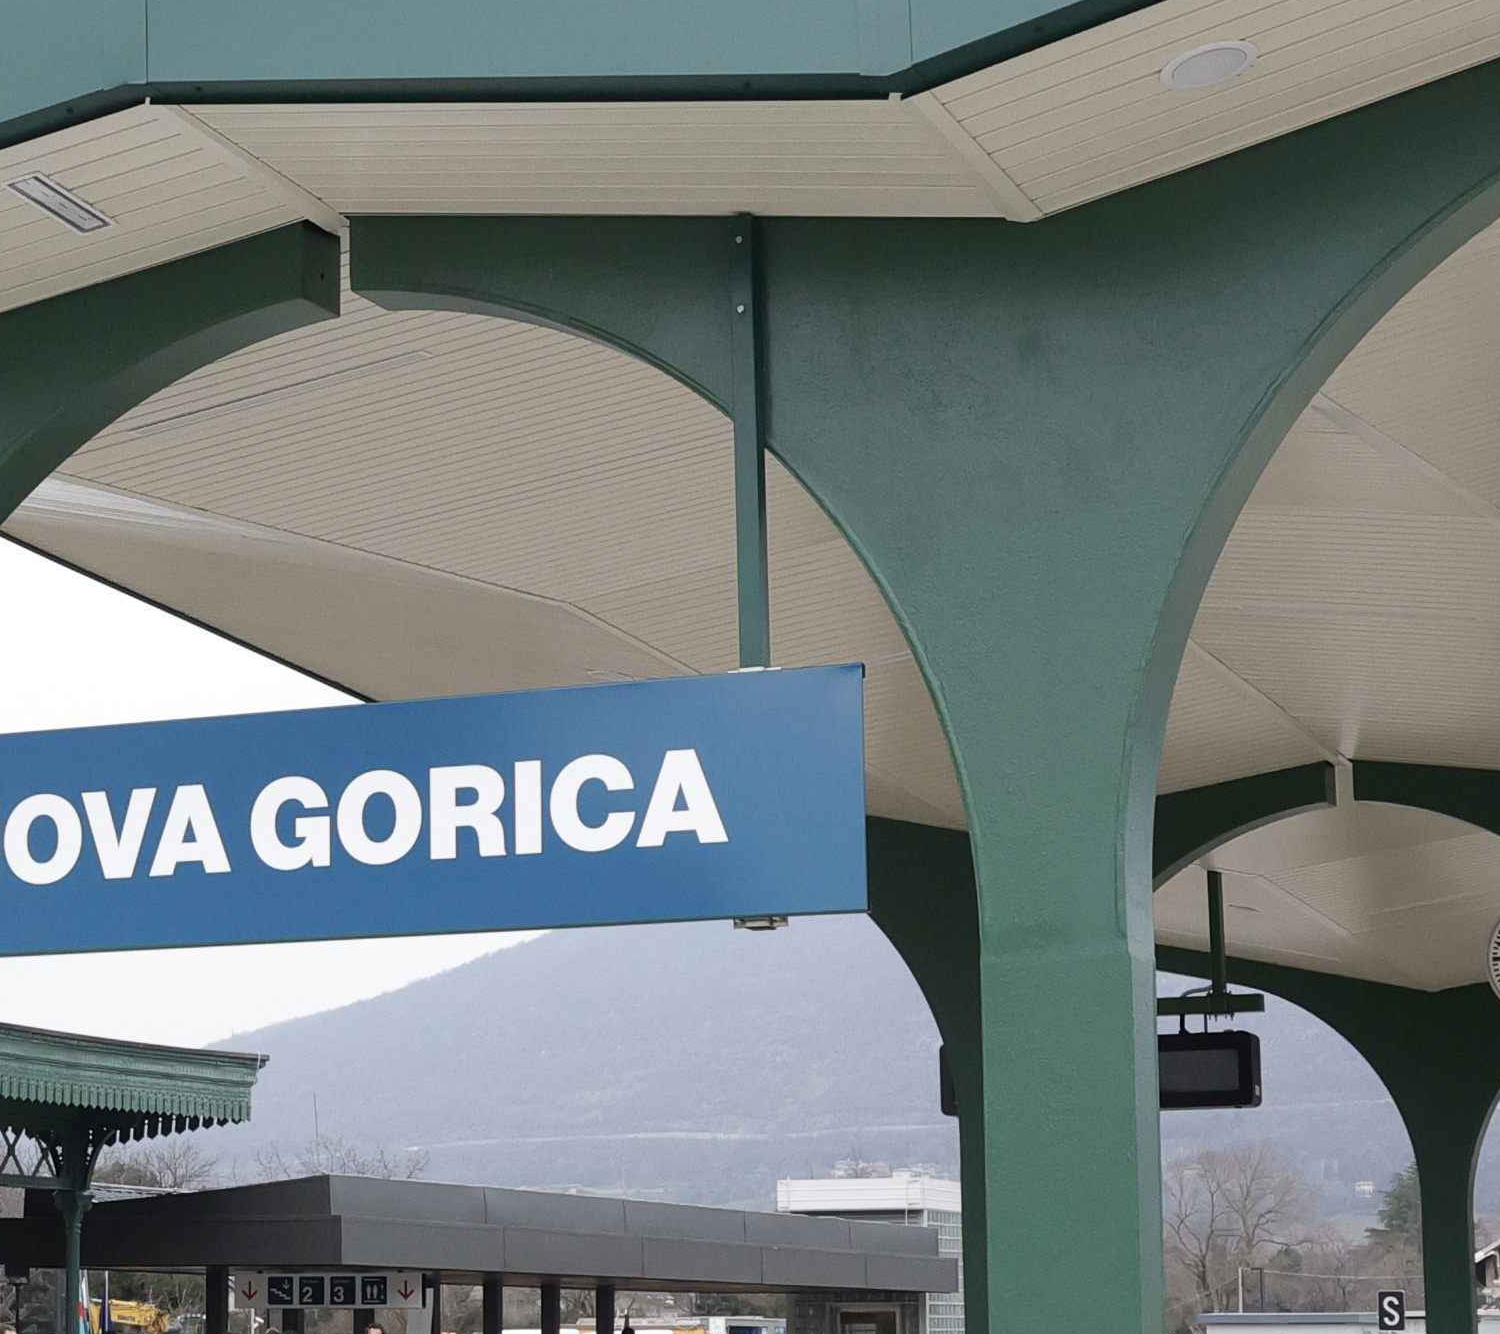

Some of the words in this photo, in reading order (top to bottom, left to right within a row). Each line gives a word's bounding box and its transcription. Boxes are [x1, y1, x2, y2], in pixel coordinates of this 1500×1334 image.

[249, 747, 730, 871] GORICA
[302, 1286, 313, 1303] 2
[333, 1286, 345, 1303] 3
[1383, 1296, 1400, 1326] S
